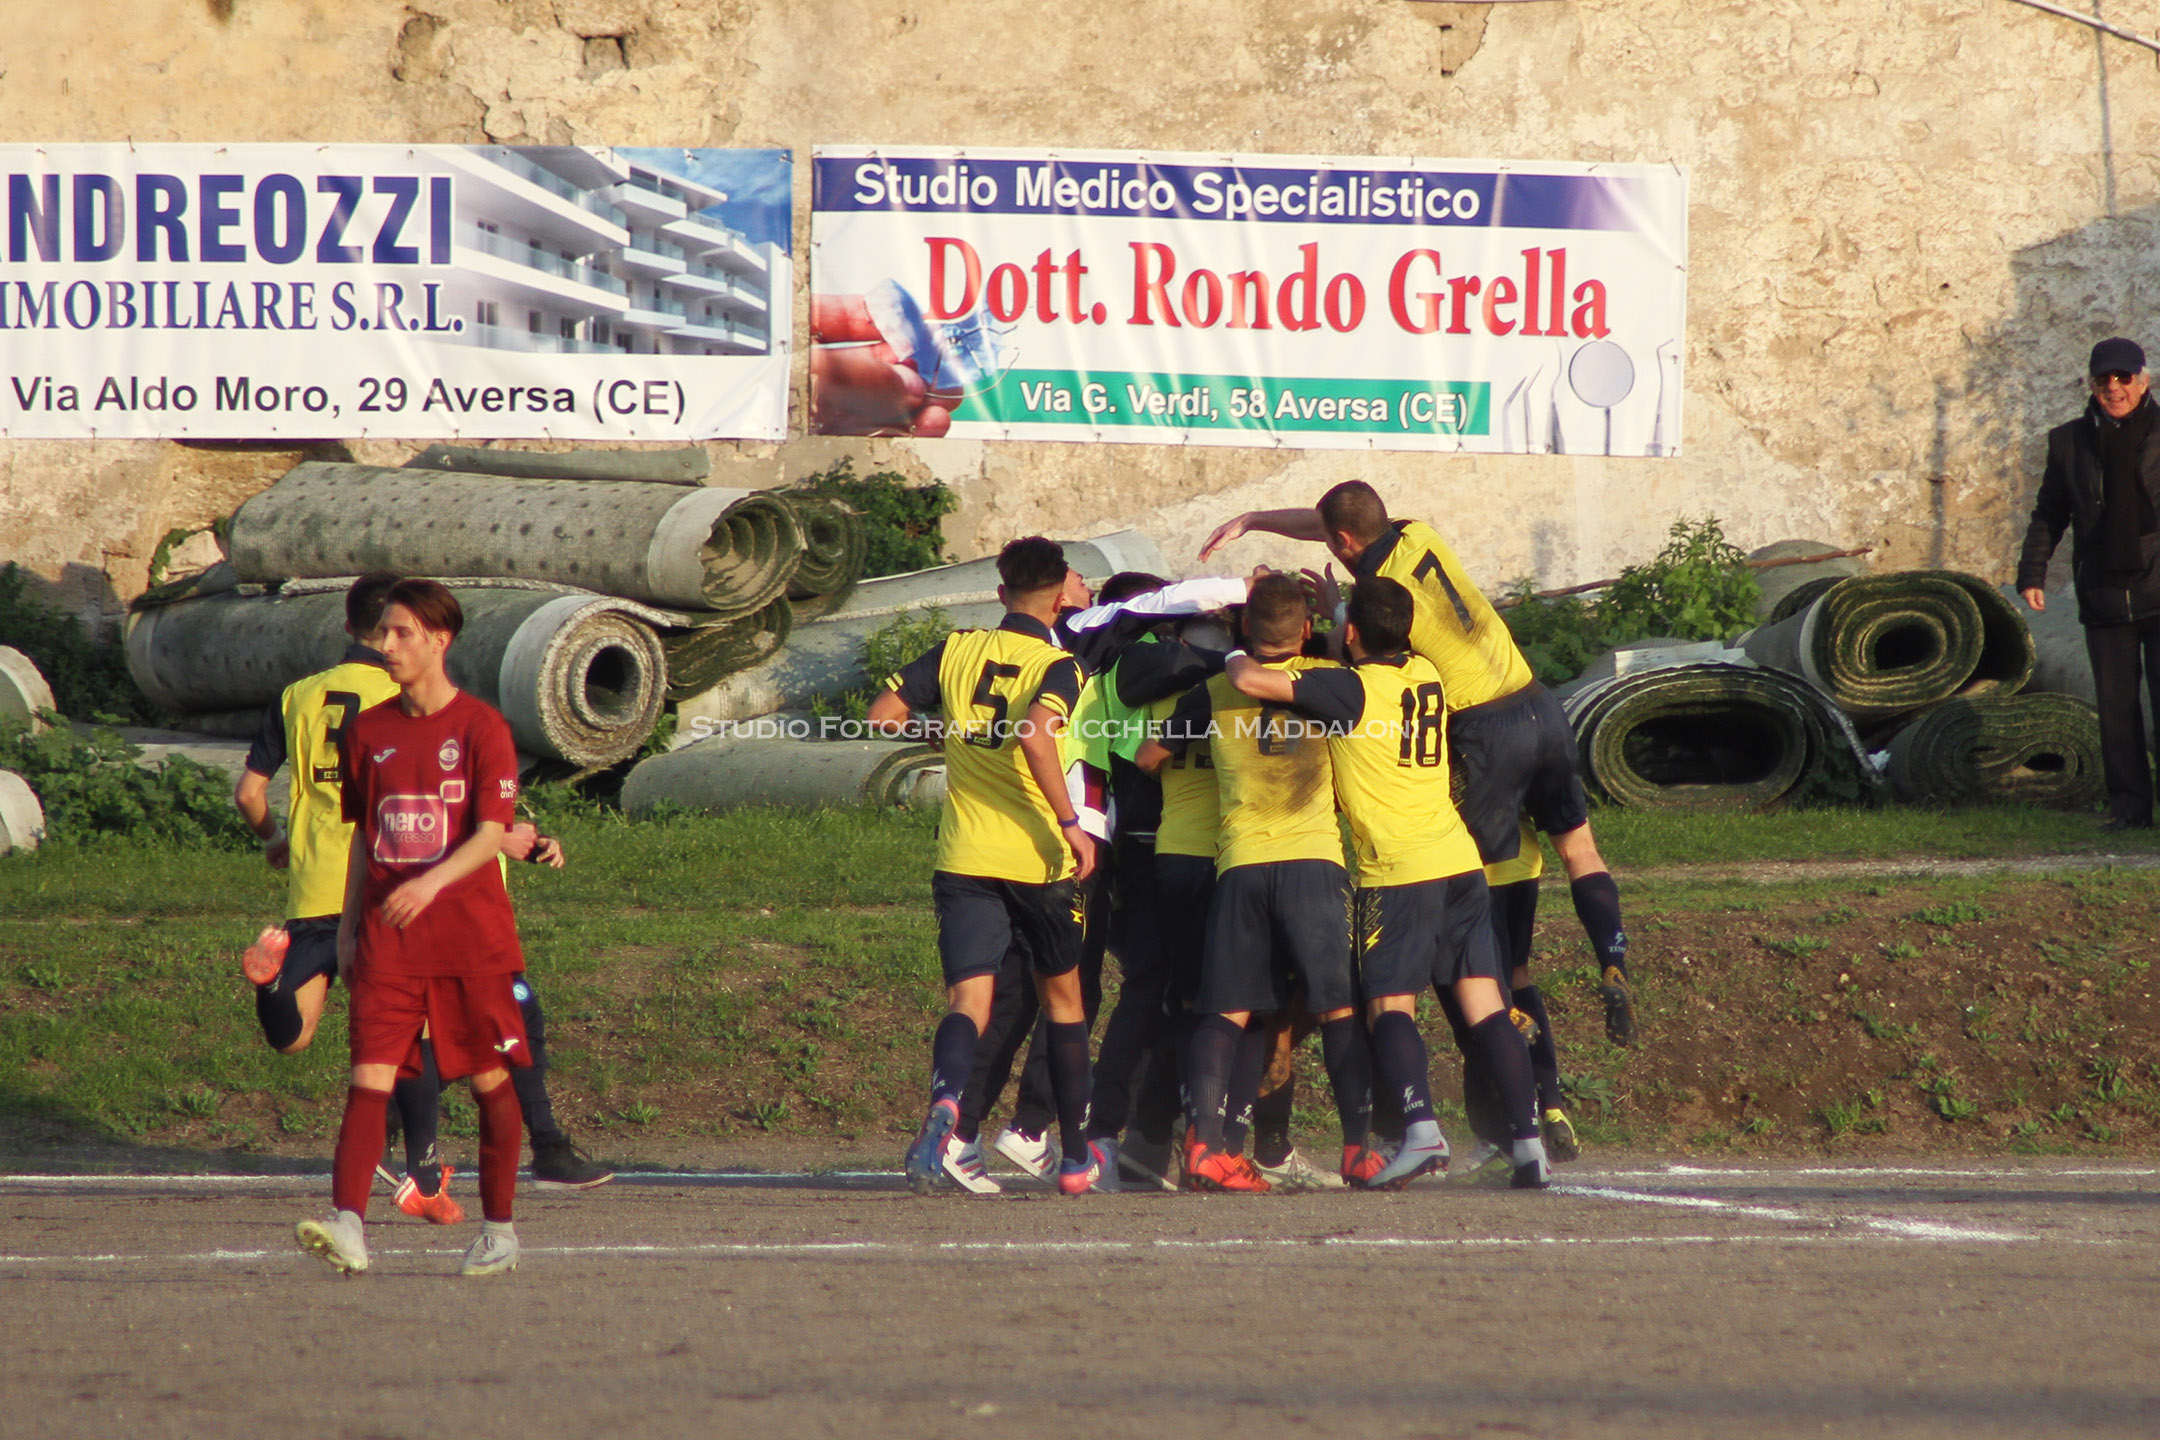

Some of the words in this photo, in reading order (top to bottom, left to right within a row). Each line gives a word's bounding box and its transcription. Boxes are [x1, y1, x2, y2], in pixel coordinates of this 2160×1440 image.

[0, 173, 452, 265] NDREOZZI
[853, 162, 998, 206] Studio
[1015, 165, 1177, 212] Medico
[1191, 171, 1481, 220] Specialistico
[330, 280, 464, 333] S.R.L.
[922, 236, 1107, 326] Dott.
[1127, 241, 1367, 334] Rondo
[1388, 246, 1612, 340] Grella
[10, 376, 79, 413] Via
[93, 376, 199, 413] Aldo
[214, 376, 341, 418] Moro,
[356, 377, 409, 413] 29
[421, 378, 577, 414] Aversa
[593, 378, 686, 424] (CE)
[1019, 381, 1072, 413] Via
[1081, 382, 1118, 414] G.
[1126, 384, 1219, 423] Verdi,
[1229, 388, 1267, 419] 58
[1274, 389, 1389, 422] Aversa
[1398, 391, 1469, 430] (CE)
[1411, 548, 1474, 634] 7
[963, 658, 1022, 750] 5
[1396, 681, 1445, 768] 18
[384, 812, 436, 832] nero
